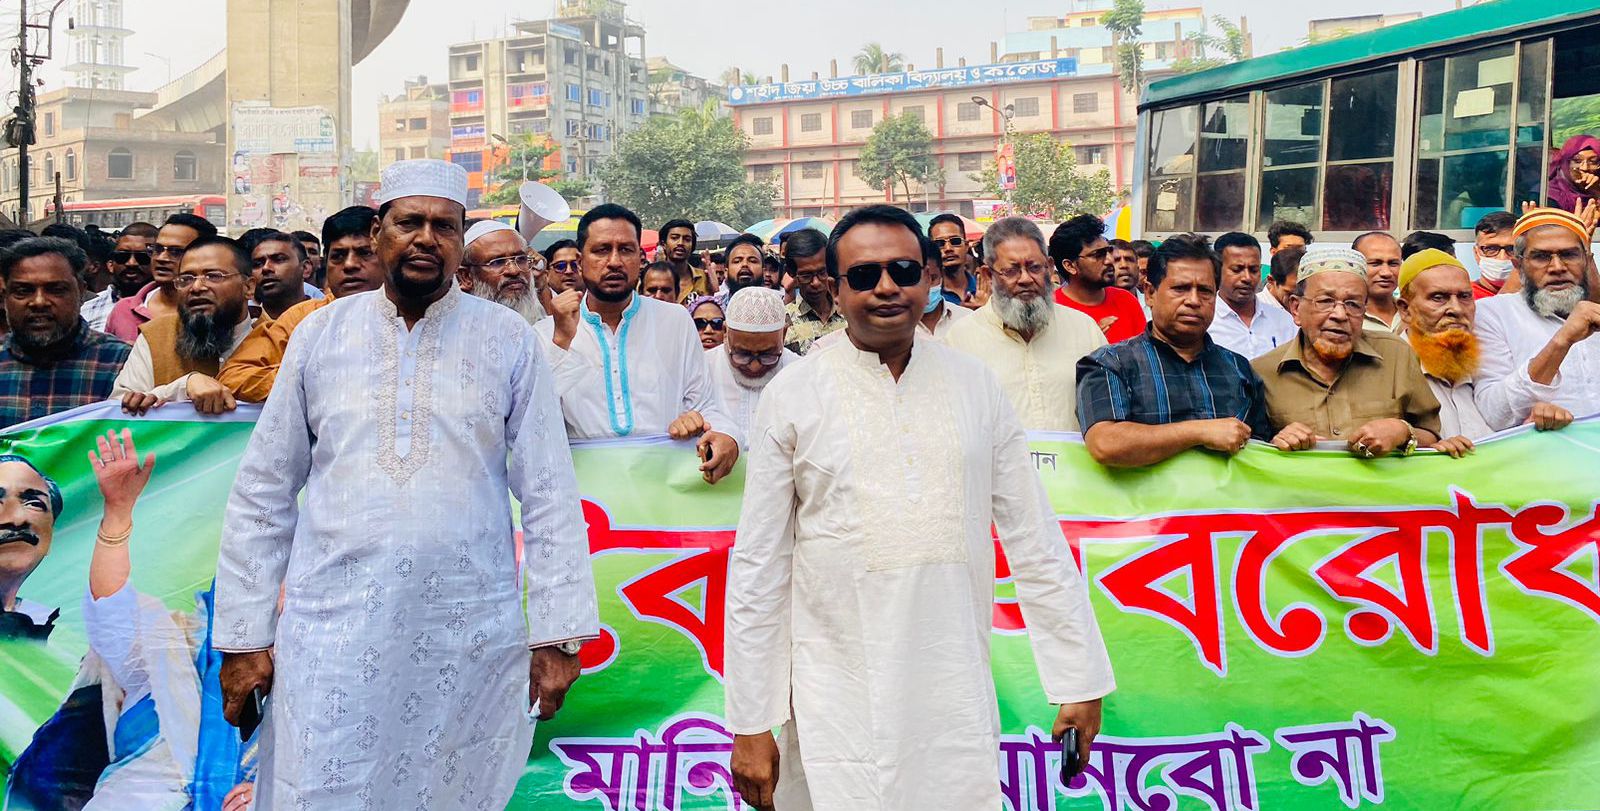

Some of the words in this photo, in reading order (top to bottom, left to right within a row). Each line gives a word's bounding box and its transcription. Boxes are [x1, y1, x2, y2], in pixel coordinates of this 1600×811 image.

[746, 84, 781, 97] শহীদ
[784, 82, 816, 95] জিয়া
[821, 78, 849, 91] উচ্চ
[852, 73, 904, 88] বালিকা
[907, 70, 967, 86] বিদ্যালয়
[971, 68, 980, 79] ও
[984, 62, 1057, 77] কলেজ
[1279, 717, 1391, 801] না
